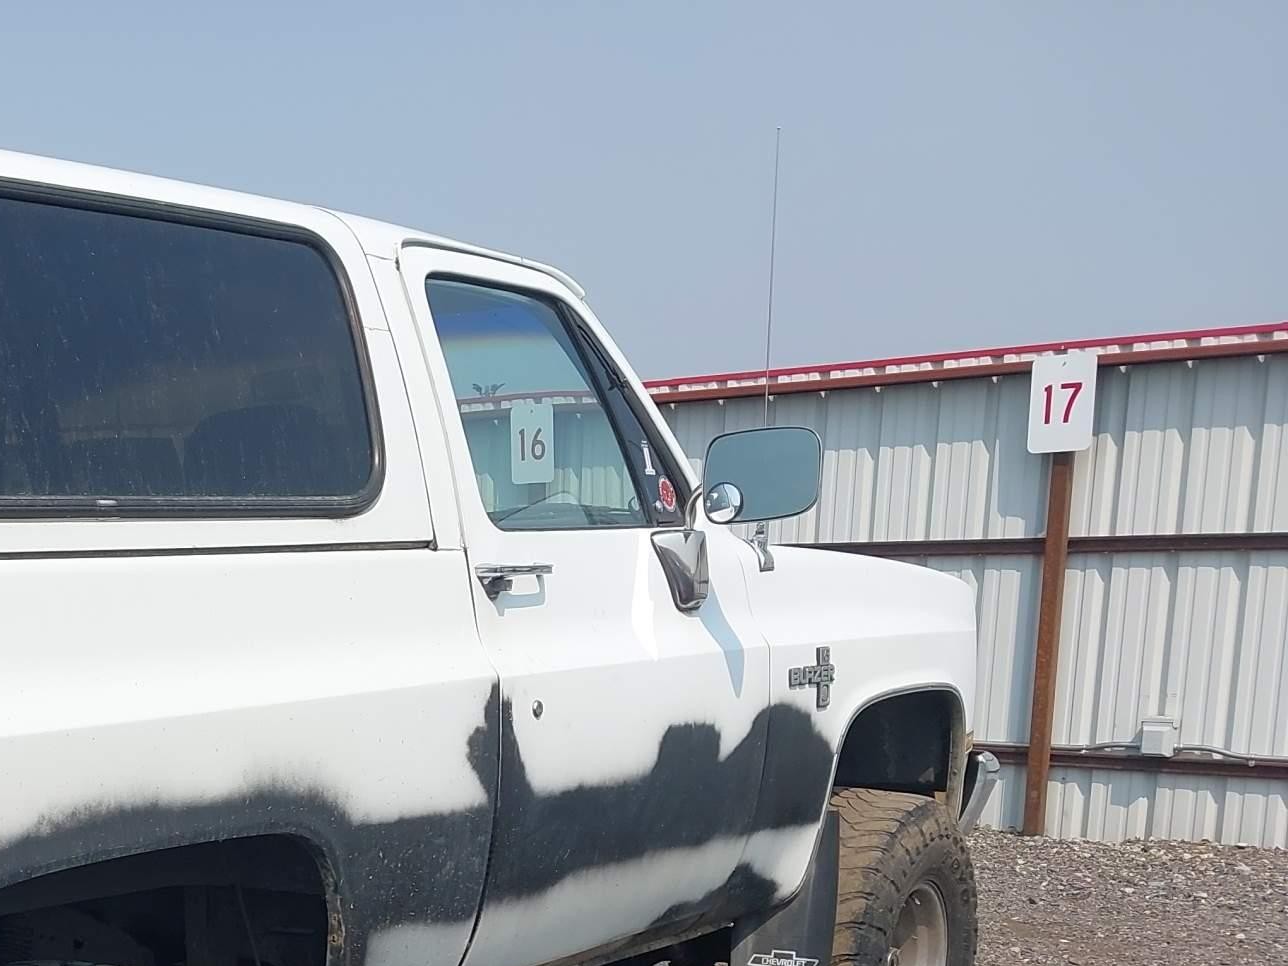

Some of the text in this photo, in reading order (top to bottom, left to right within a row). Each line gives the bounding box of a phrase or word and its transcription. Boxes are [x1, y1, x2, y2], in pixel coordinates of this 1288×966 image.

[1044, 382, 1083, 425] 17
[518, 427, 546, 462] 16
[791, 664, 834, 686] BLAZER
